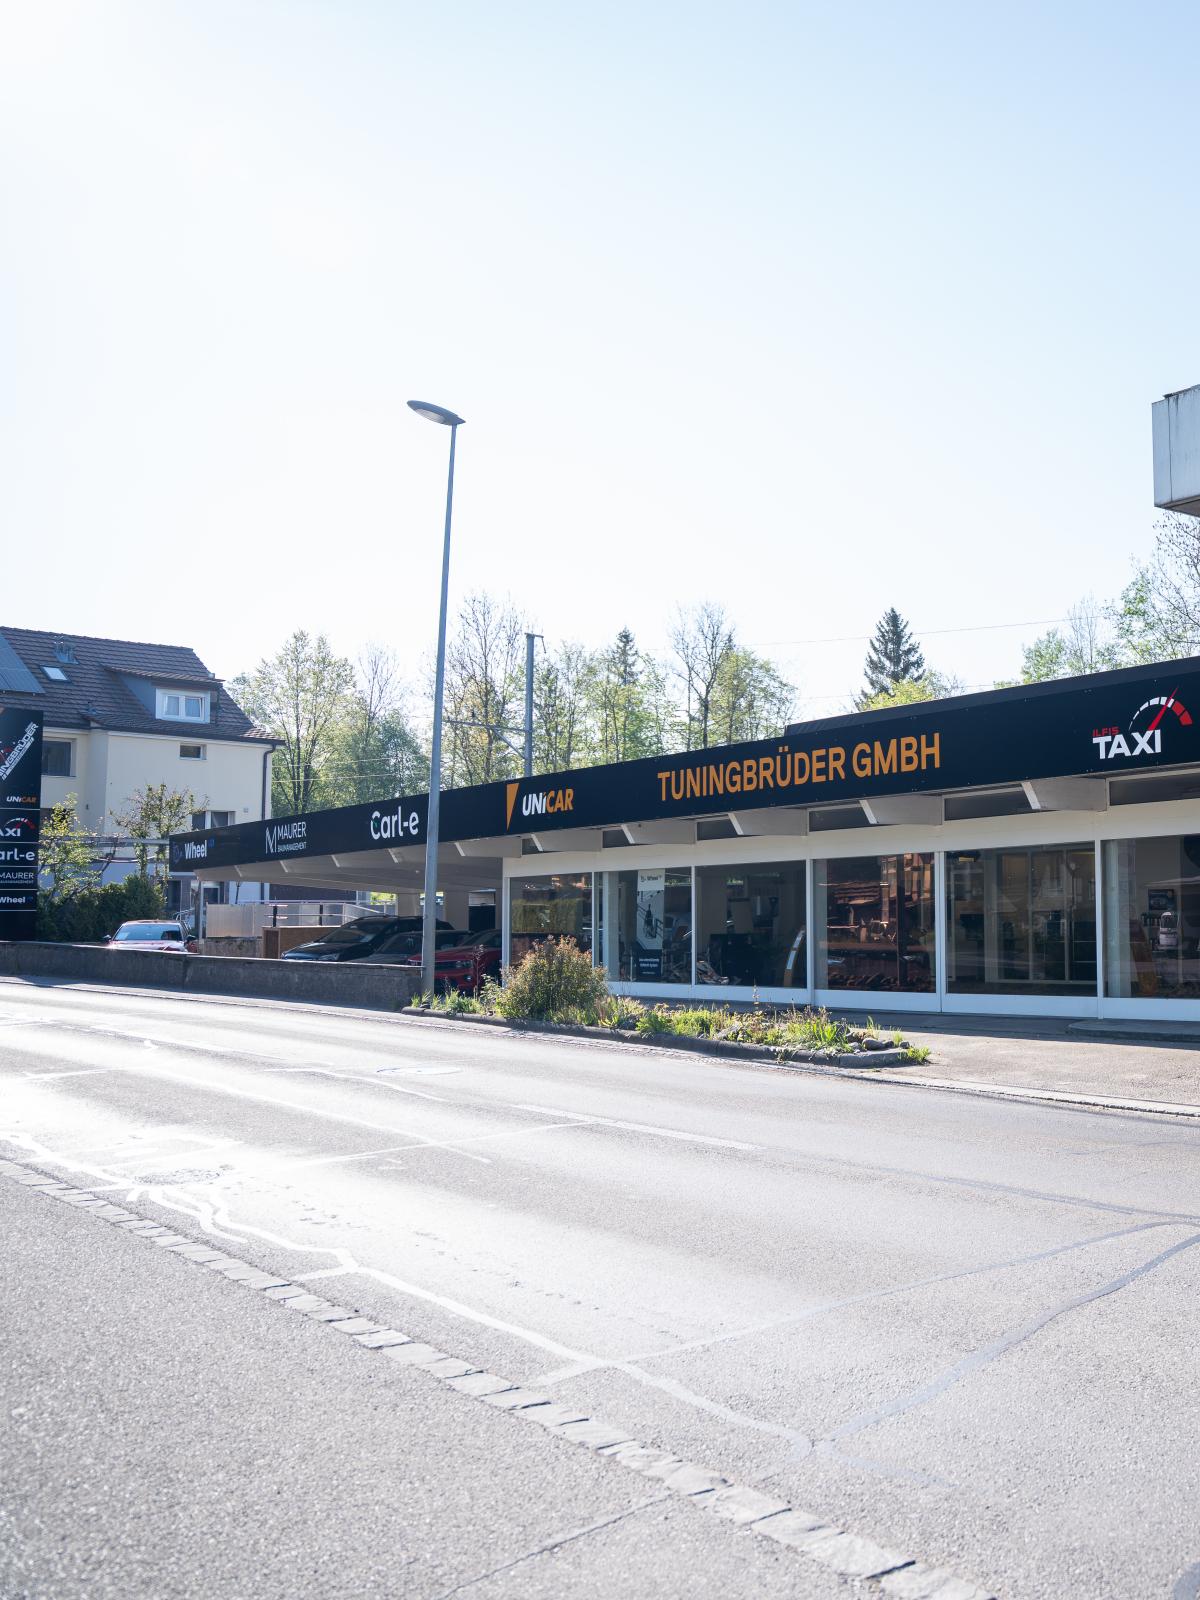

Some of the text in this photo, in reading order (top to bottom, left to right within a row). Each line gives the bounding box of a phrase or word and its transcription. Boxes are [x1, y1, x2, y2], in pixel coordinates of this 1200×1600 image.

[1092, 729, 1161, 759] TAXI
[657, 732, 940, 801] TUNINGBRÜDER GMBH
[277, 821, 307, 840] MAURER
[370, 806, 419, 840] Carl-e
[184, 839, 207, 860] Wheel
